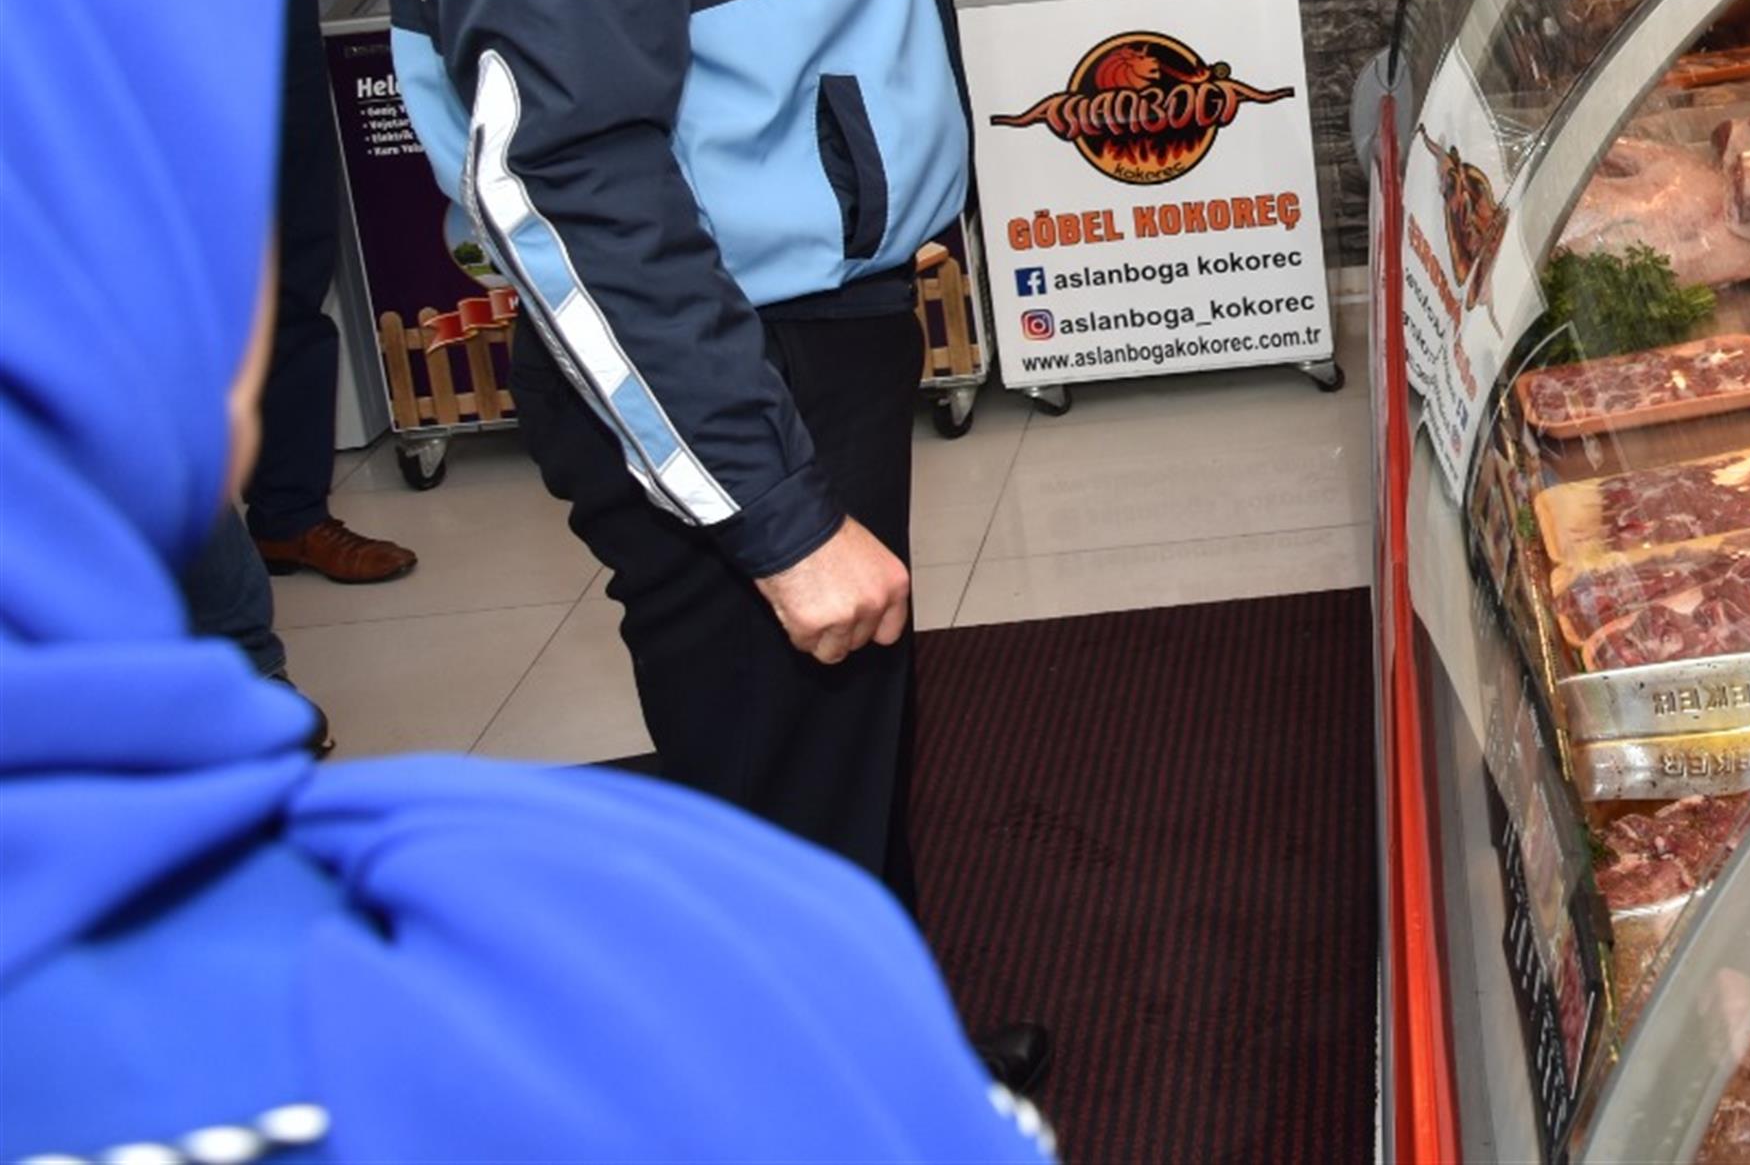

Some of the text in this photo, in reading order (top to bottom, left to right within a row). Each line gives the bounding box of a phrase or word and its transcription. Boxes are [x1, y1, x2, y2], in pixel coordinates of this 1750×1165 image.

[1007, 192, 1301, 251] GÖBEL KOKOREÇ
[1054, 249, 1302, 292] aslanboga kokorec
[1059, 293, 1315, 335] aslanboga_kokorec
[1021, 326, 1321, 372] www.aslanbogakokorec.com.tr
